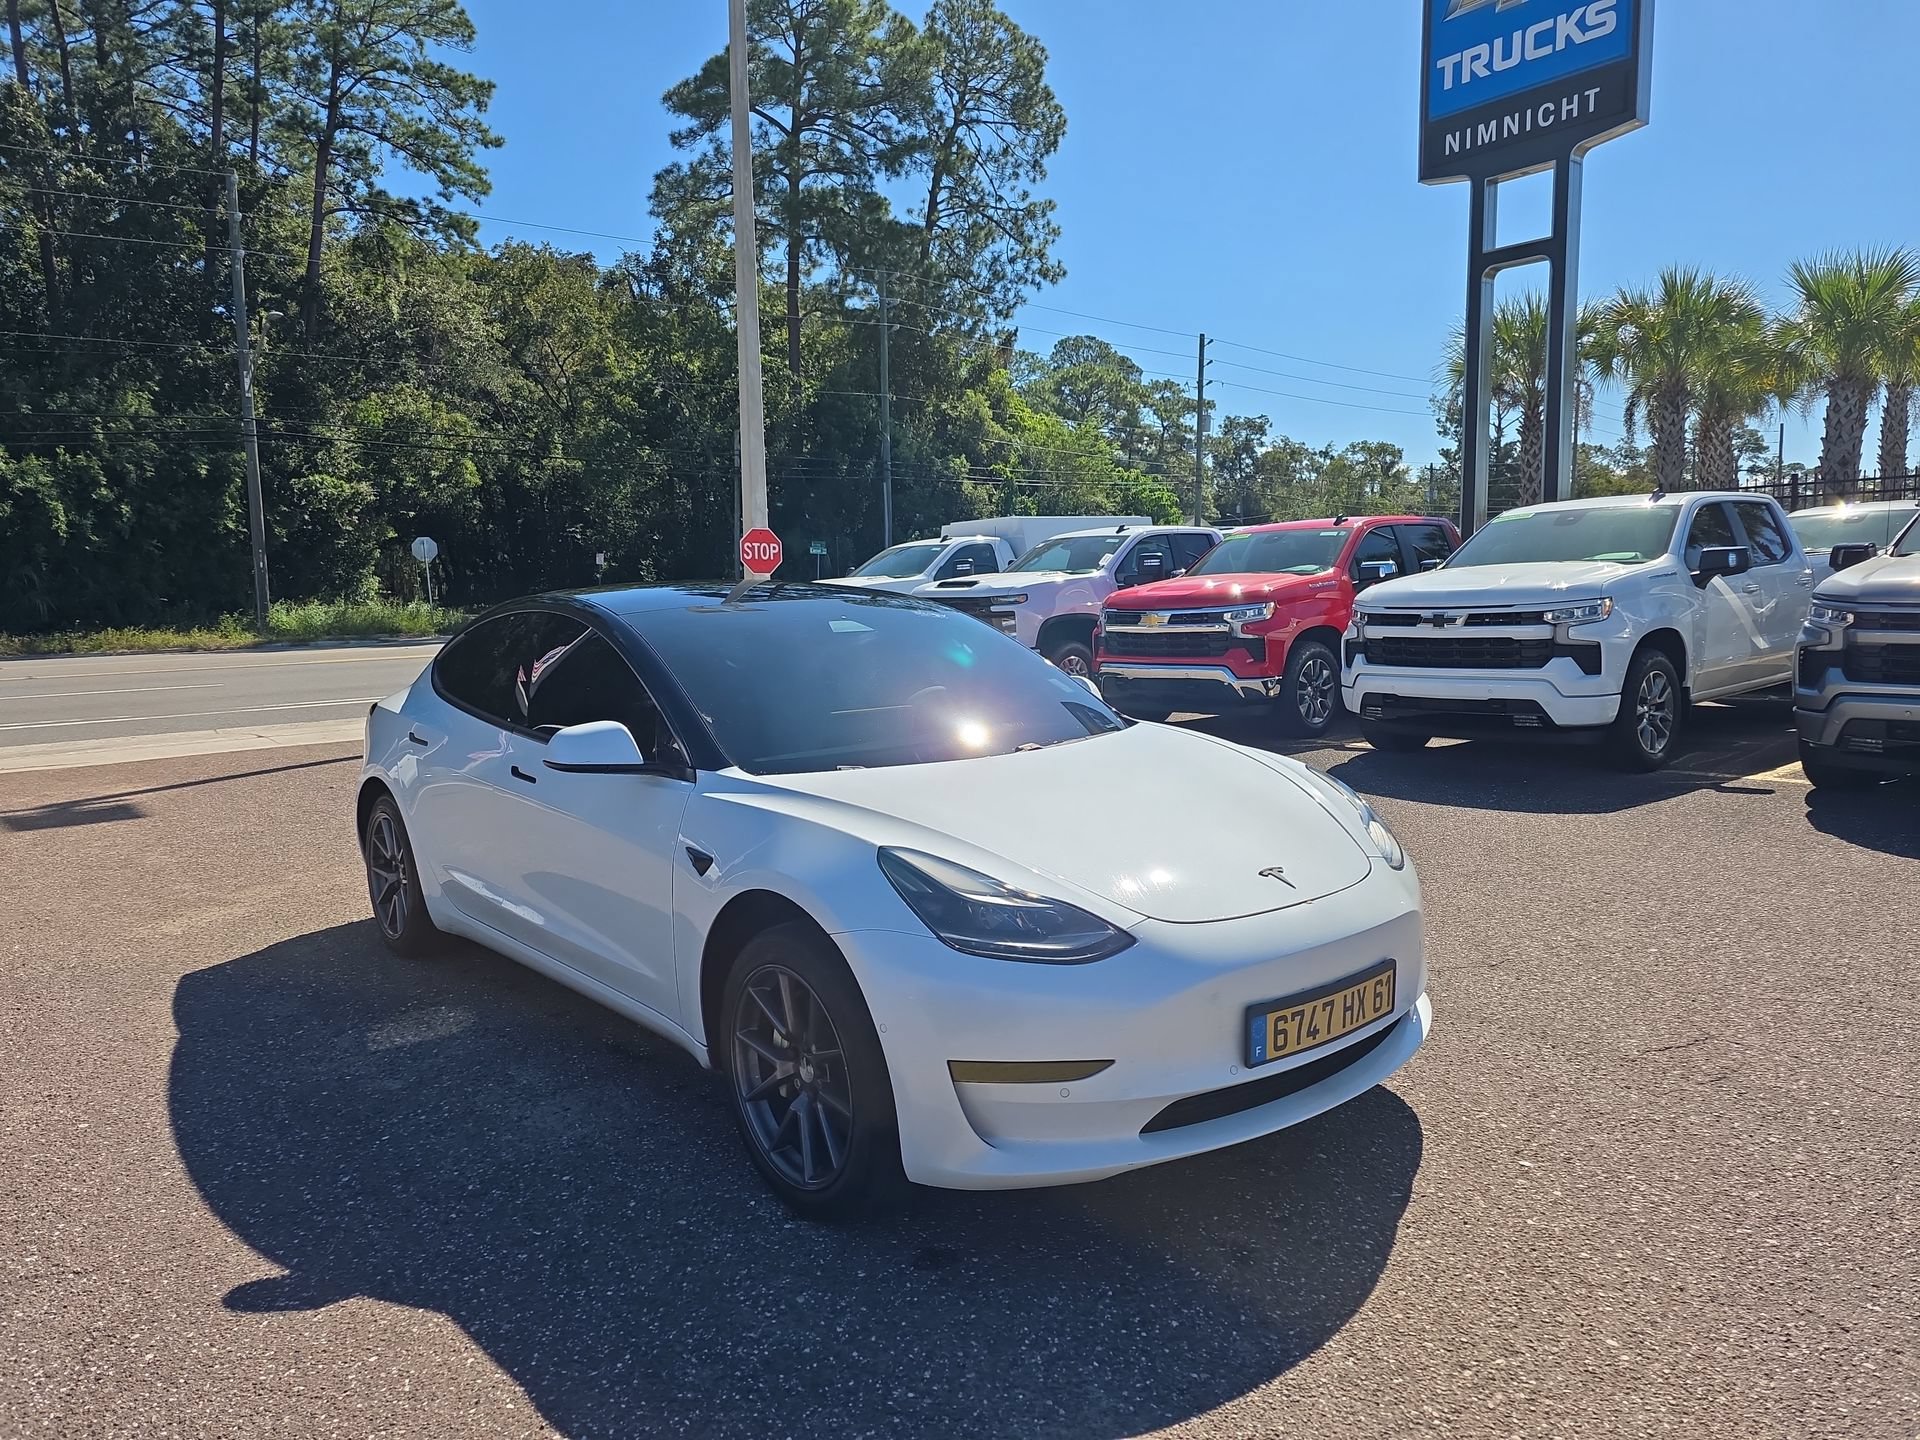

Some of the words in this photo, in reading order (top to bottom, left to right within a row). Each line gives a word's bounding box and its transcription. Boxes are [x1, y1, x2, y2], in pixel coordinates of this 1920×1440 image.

[1436, 0, 1618, 90] TRUCKS
[1444, 87, 1601, 156] NIMNICHT
[743, 542, 779, 561] STOP
[1273, 999, 1335, 1052] 6747
[1342, 986, 1367, 1029] HX
[1373, 974, 1392, 1014] 61
[1255, 1046, 1262, 1057] F
